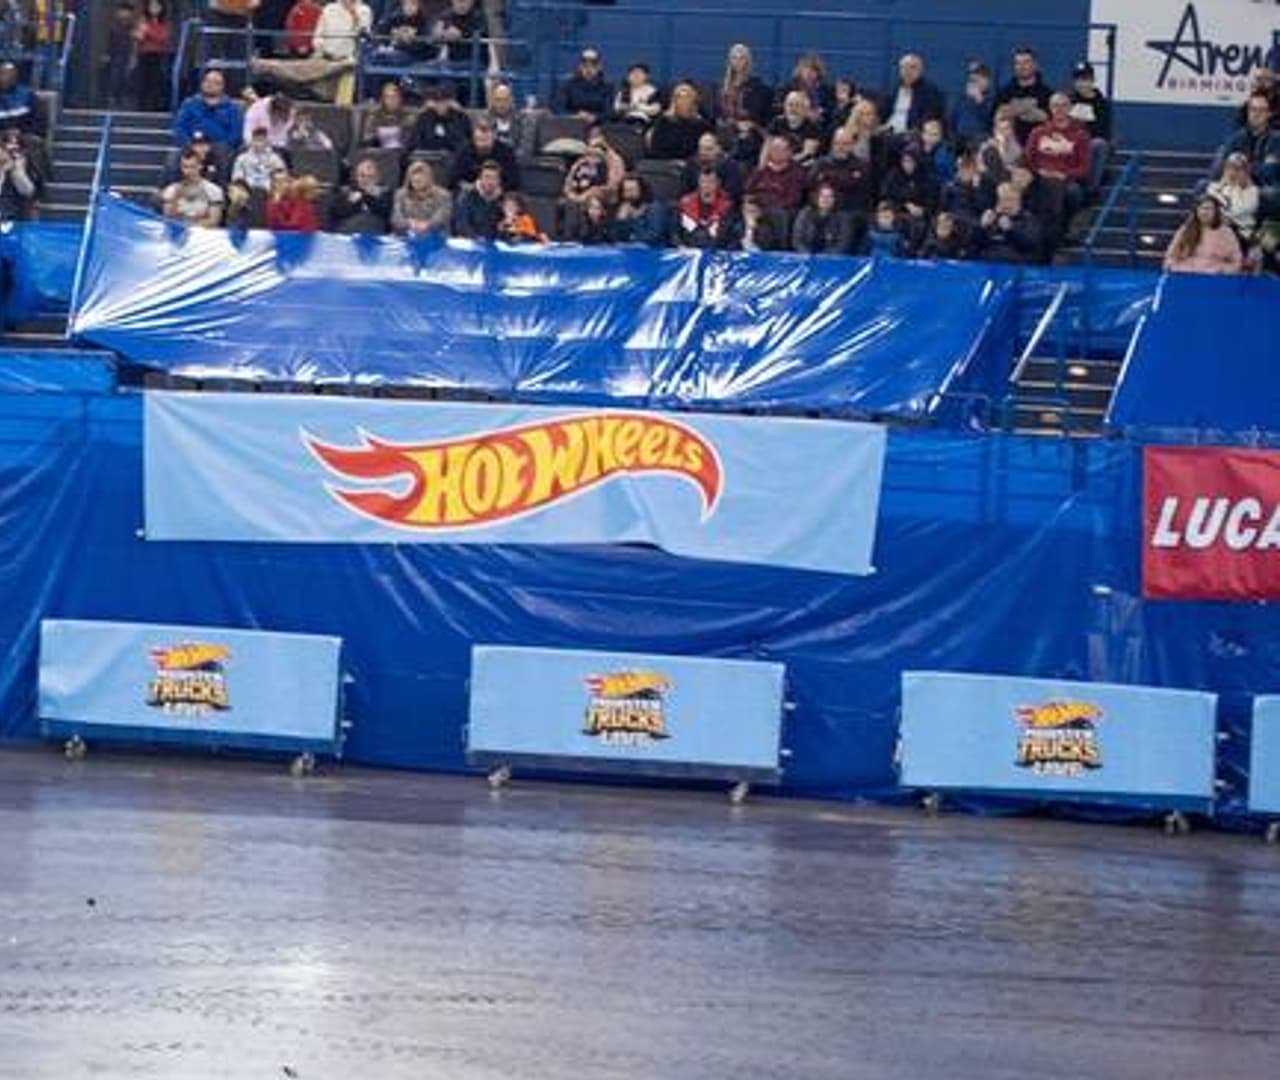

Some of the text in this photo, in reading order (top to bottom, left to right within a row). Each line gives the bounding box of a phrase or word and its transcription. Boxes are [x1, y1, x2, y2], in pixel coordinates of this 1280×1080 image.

[1145, 2, 1268, 88] Aren
[1168, 78, 1255, 92] BIRMING
[1151, 496, 1280, 549] LUCA
